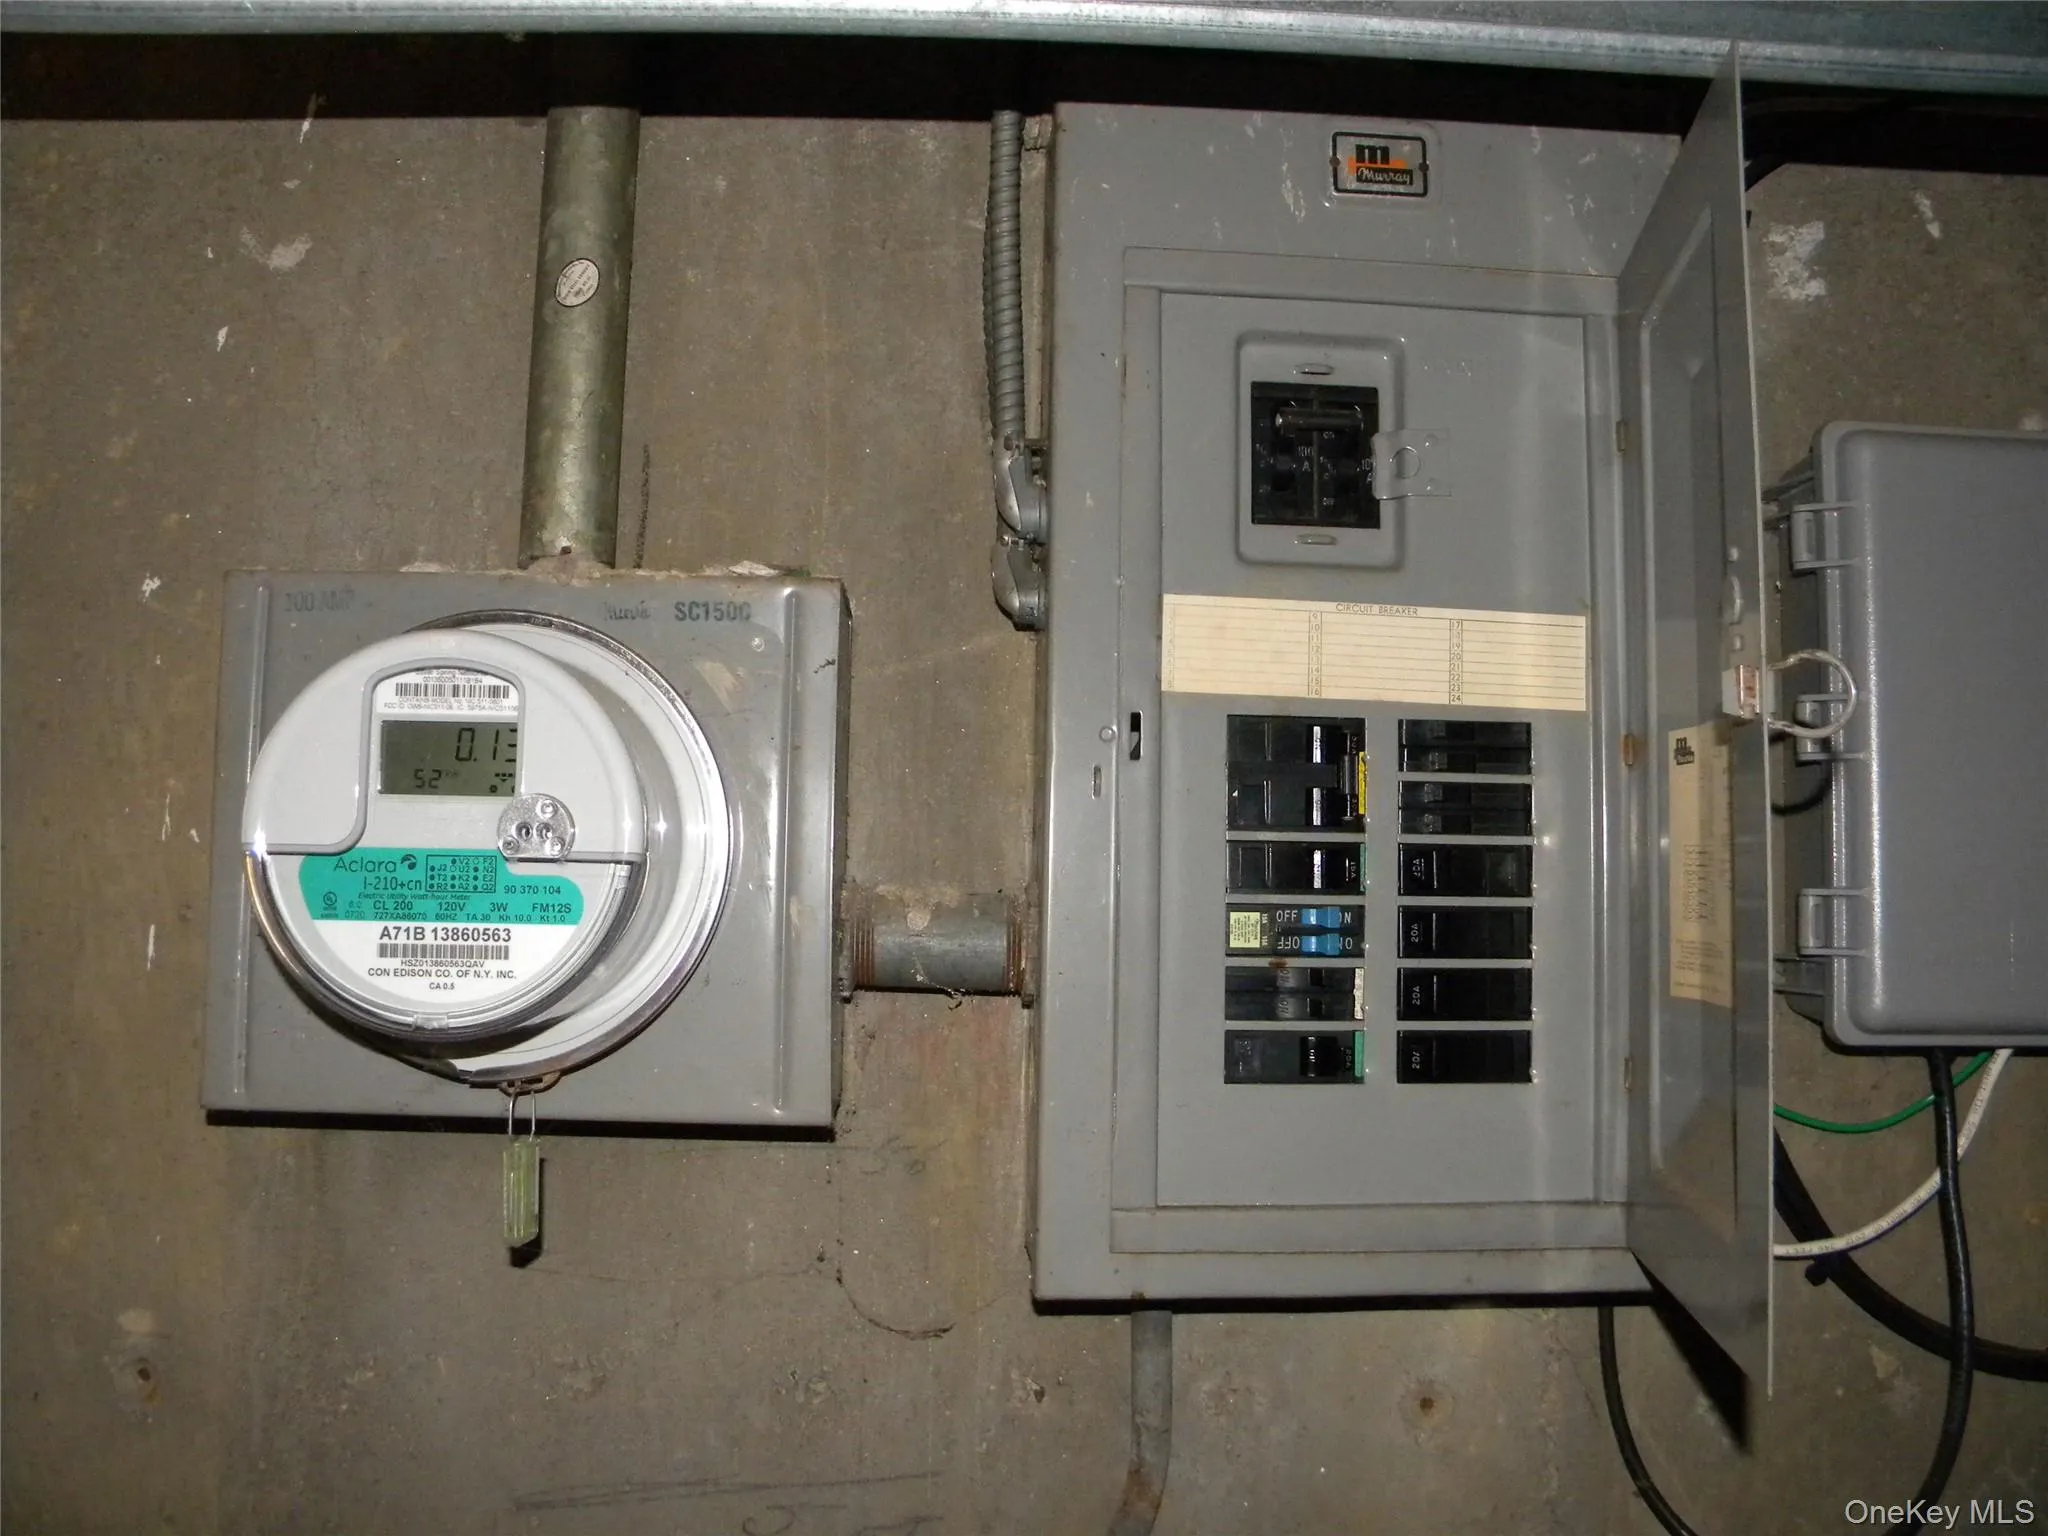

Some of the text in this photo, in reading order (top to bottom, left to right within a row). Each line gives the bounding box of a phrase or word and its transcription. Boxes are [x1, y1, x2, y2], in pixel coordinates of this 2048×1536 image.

[1357, 167, 1411, 185] Murray
[1336, 603, 1418, 616] CIRCUIT BREAKER
[414, 769, 442, 789] 52
[333, 857, 397, 873] Aclara
[504, 885, 561, 895] 90 370 104
[373, 900, 572, 913] CL 200 120V 3W FM12S
[466, 913, 479, 921] TA
[480, 913, 491, 921] 30
[552, 914, 565, 922] 1.0
[1276, 910, 1298, 922] OFF
[379, 926, 511, 942] A71B 13860563
[1410, 923, 1419, 943] 20A
[1277, 936, 1300, 950] OFF
[400, 959, 485, 968] HSZ013860563QAV
[368, 968, 517, 979] CON EDISON CO. OF N.Y. INC.
[429, 982, 442, 990] CA
[1412, 985, 1420, 1005] 20A
